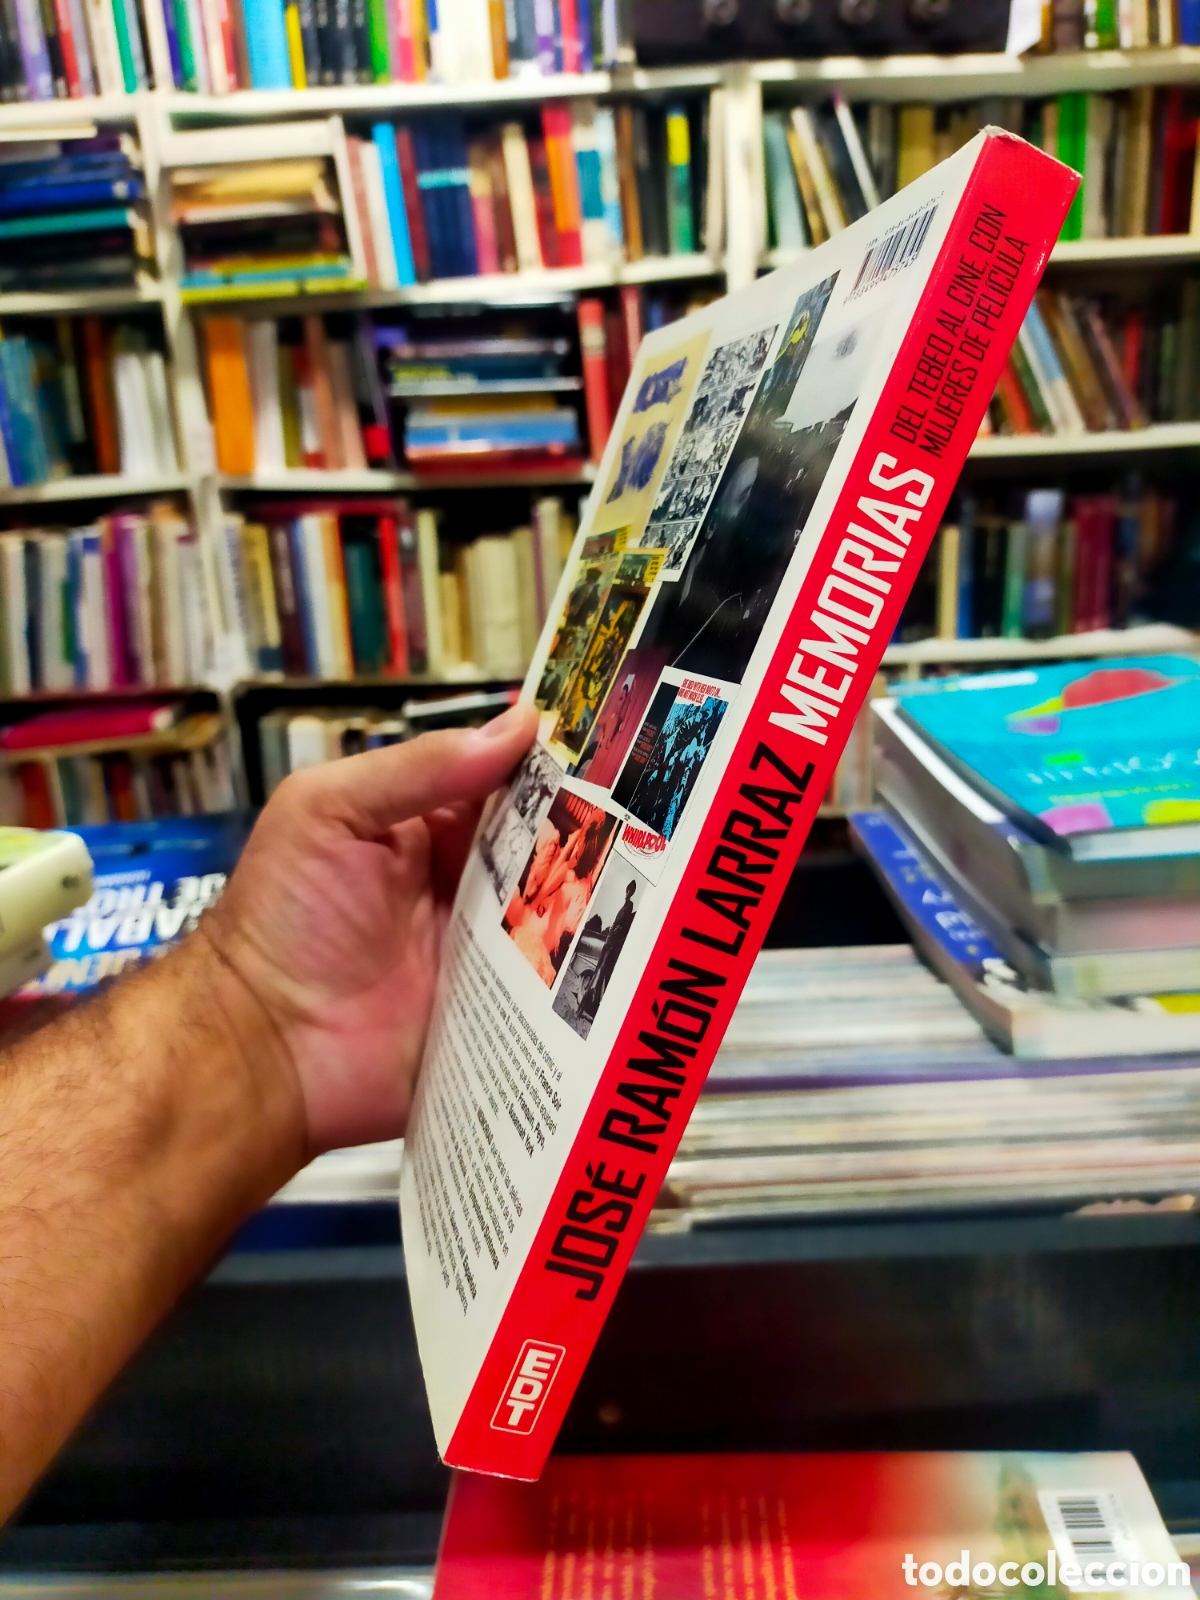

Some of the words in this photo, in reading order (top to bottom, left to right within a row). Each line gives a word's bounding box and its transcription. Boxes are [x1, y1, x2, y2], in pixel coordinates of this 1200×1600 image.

[969, 203, 1007, 254] CON
[947, 254, 988, 307] CINE,
[971, 235, 1029, 332] PELÍCULA
[936, 309, 965, 337] AL
[959, 328, 991, 362] DE
[906, 333, 954, 400] TEBEO
[890, 404, 927, 444] DEL
[918, 360, 978, 458] MUJERES
[543, 1162, 647, 1301] JOSÉ
[598, 959, 727, 1155] RAMÓN
[681, 741, 815, 957] LARRAZ
[768, 452, 935, 745] MEMORIAS
[519, 1039, 533, 1062] cómics
[537, 1069, 554, 1097] France
[550, 1091, 562, 1111] Soir
[536, 1039, 545, 1053] del
[542, 1047, 556, 1070] cómic
[509, 1078, 519, 1097] como
[532, 1122, 547, 1150] Peyo,
[511, 1051, 522, 1072] terror
[518, 1068, 527, 1085] que
[528, 1082, 542, 1107] crítica
[537, 1100, 558, 1138] equiparó
[508, 1102, 526, 1139] Susannah
[523, 1134, 535, 1157] York
[476, 1105, 494, 1145] MEMORIAS
[489, 1141, 498, 1160] que
[495, 1151, 507, 1177] harán
[503, 1171, 512, 1188] las
[508, 1182, 524, 1217] delicias
[449, 1209, 460, 1240] Guerra
[474, 1166, 486, 1195] director
[483, 1191, 505, 1247] especializado
[483, 1155, 495, 1181] Larraz
[491, 1176, 500, 1194] fue
[496, 1191, 505, 1208] uno
[506, 1215, 515, 1233] los
[457, 1236, 466, 1259] Civil
[469, 1223, 482, 1257] mundo.
[461, 1254, 478, 1301] Española
[506, 1348, 556, 1426] EDT
